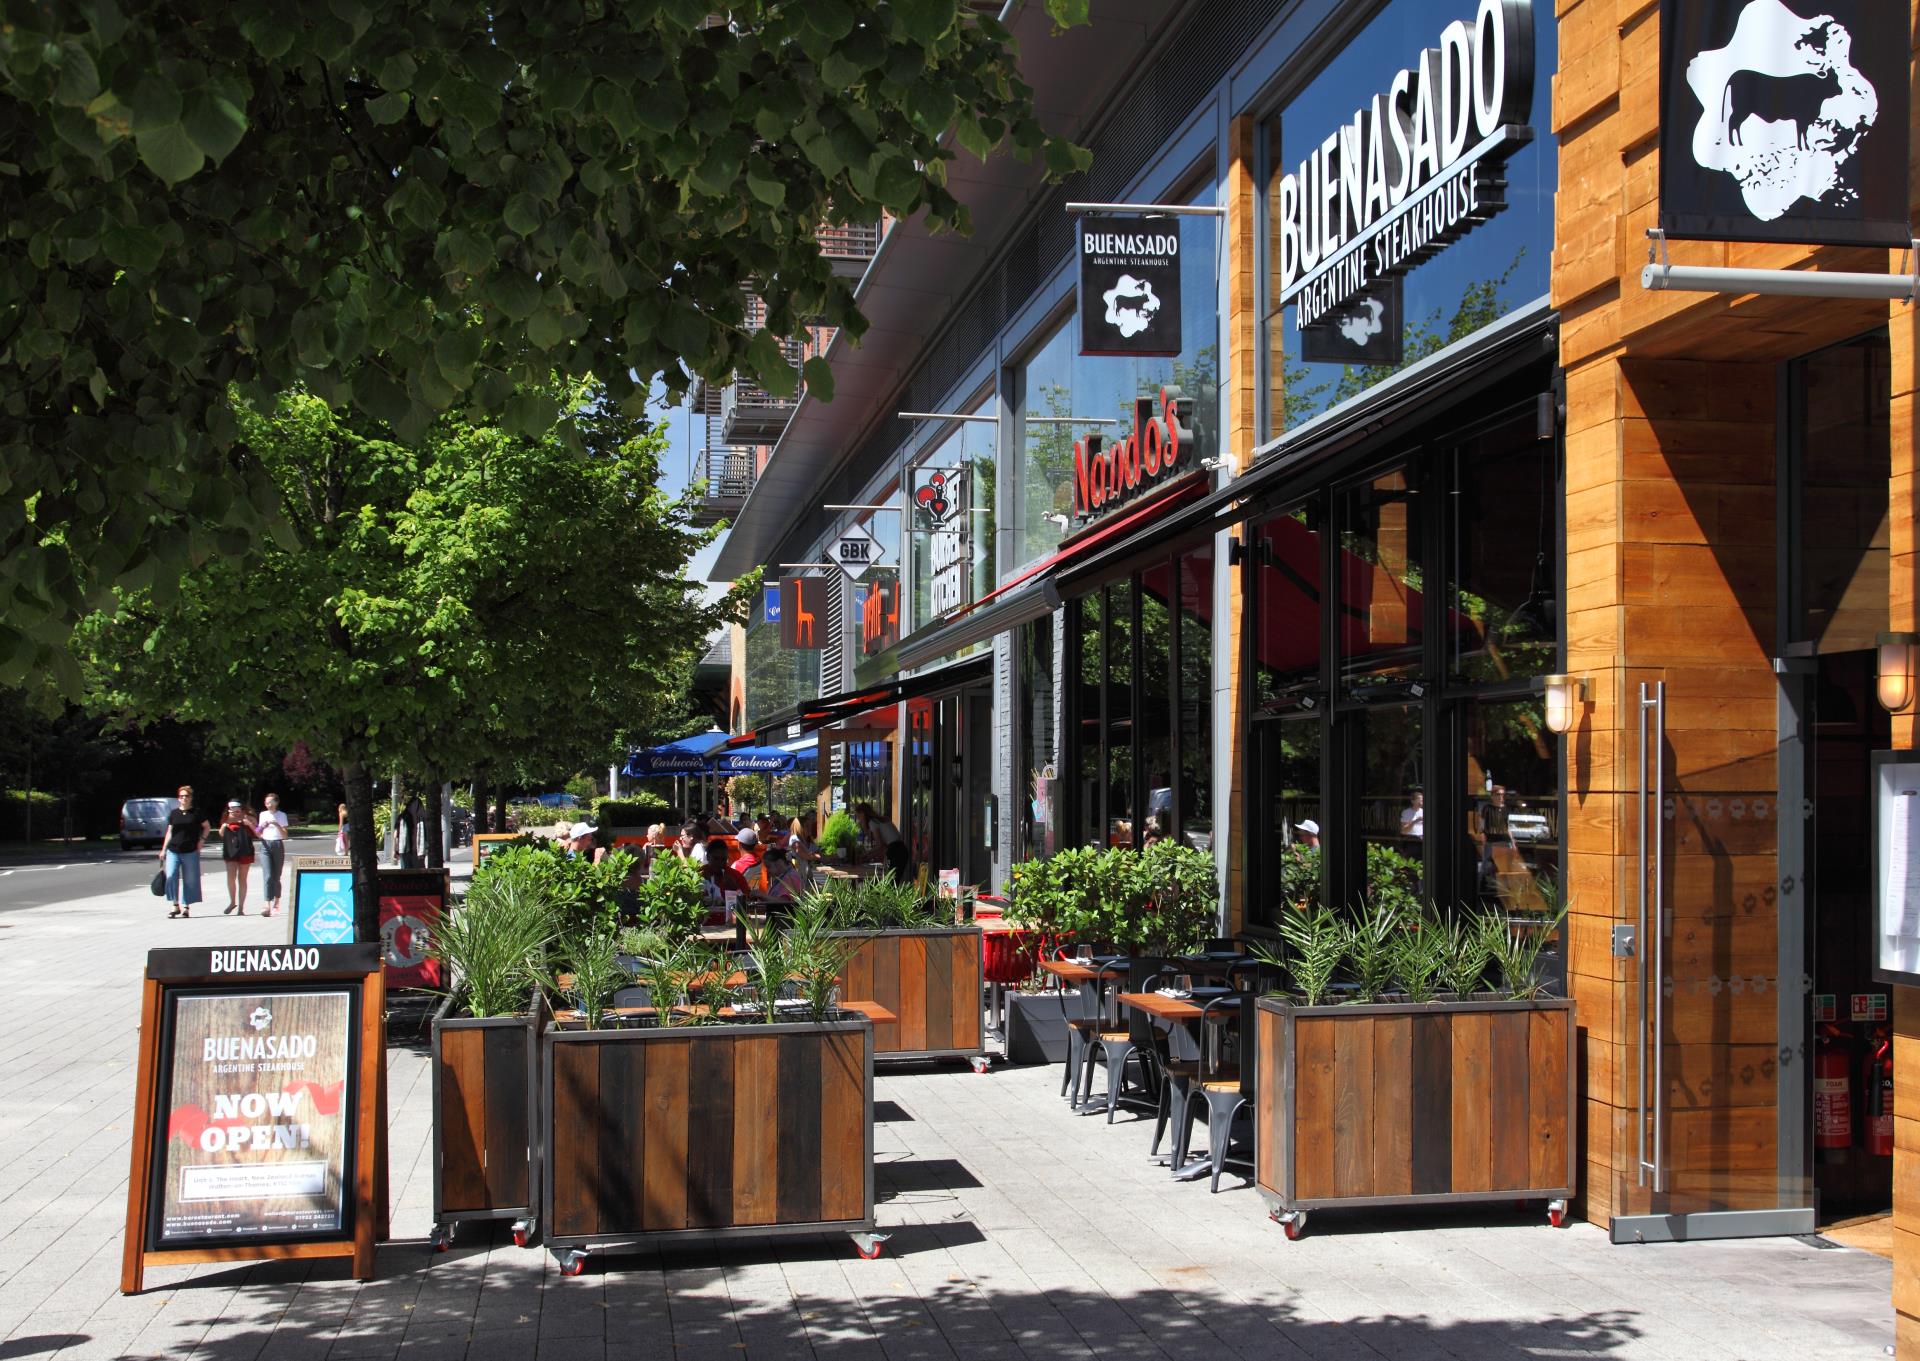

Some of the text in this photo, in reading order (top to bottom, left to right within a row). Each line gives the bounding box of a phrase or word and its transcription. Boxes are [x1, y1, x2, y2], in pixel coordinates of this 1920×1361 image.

[1280, 0, 1505, 289] BUENASADO
[1084, 233, 1178, 256] BUENASADO
[1296, 161, 1479, 331] ARGENTINE STEAKHOUSE
[1093, 257, 1169, 266] ARGENTINE STEAKHOUSE
[1073, 385, 1179, 519] Nando's
[840, 543, 870, 559] GBK
[650, 755, 704, 769] Carluccio's
[730, 755, 783, 768] Carluccio's
[210, 947, 320, 973] BUENASADO
[203, 1035, 317, 1061] BUENASADO
[213, 1062, 305, 1073] ARGENTINE STEAKHOUSE
[213, 1091, 303, 1120] NOW
[200, 1123, 311, 1153] OPEN!
